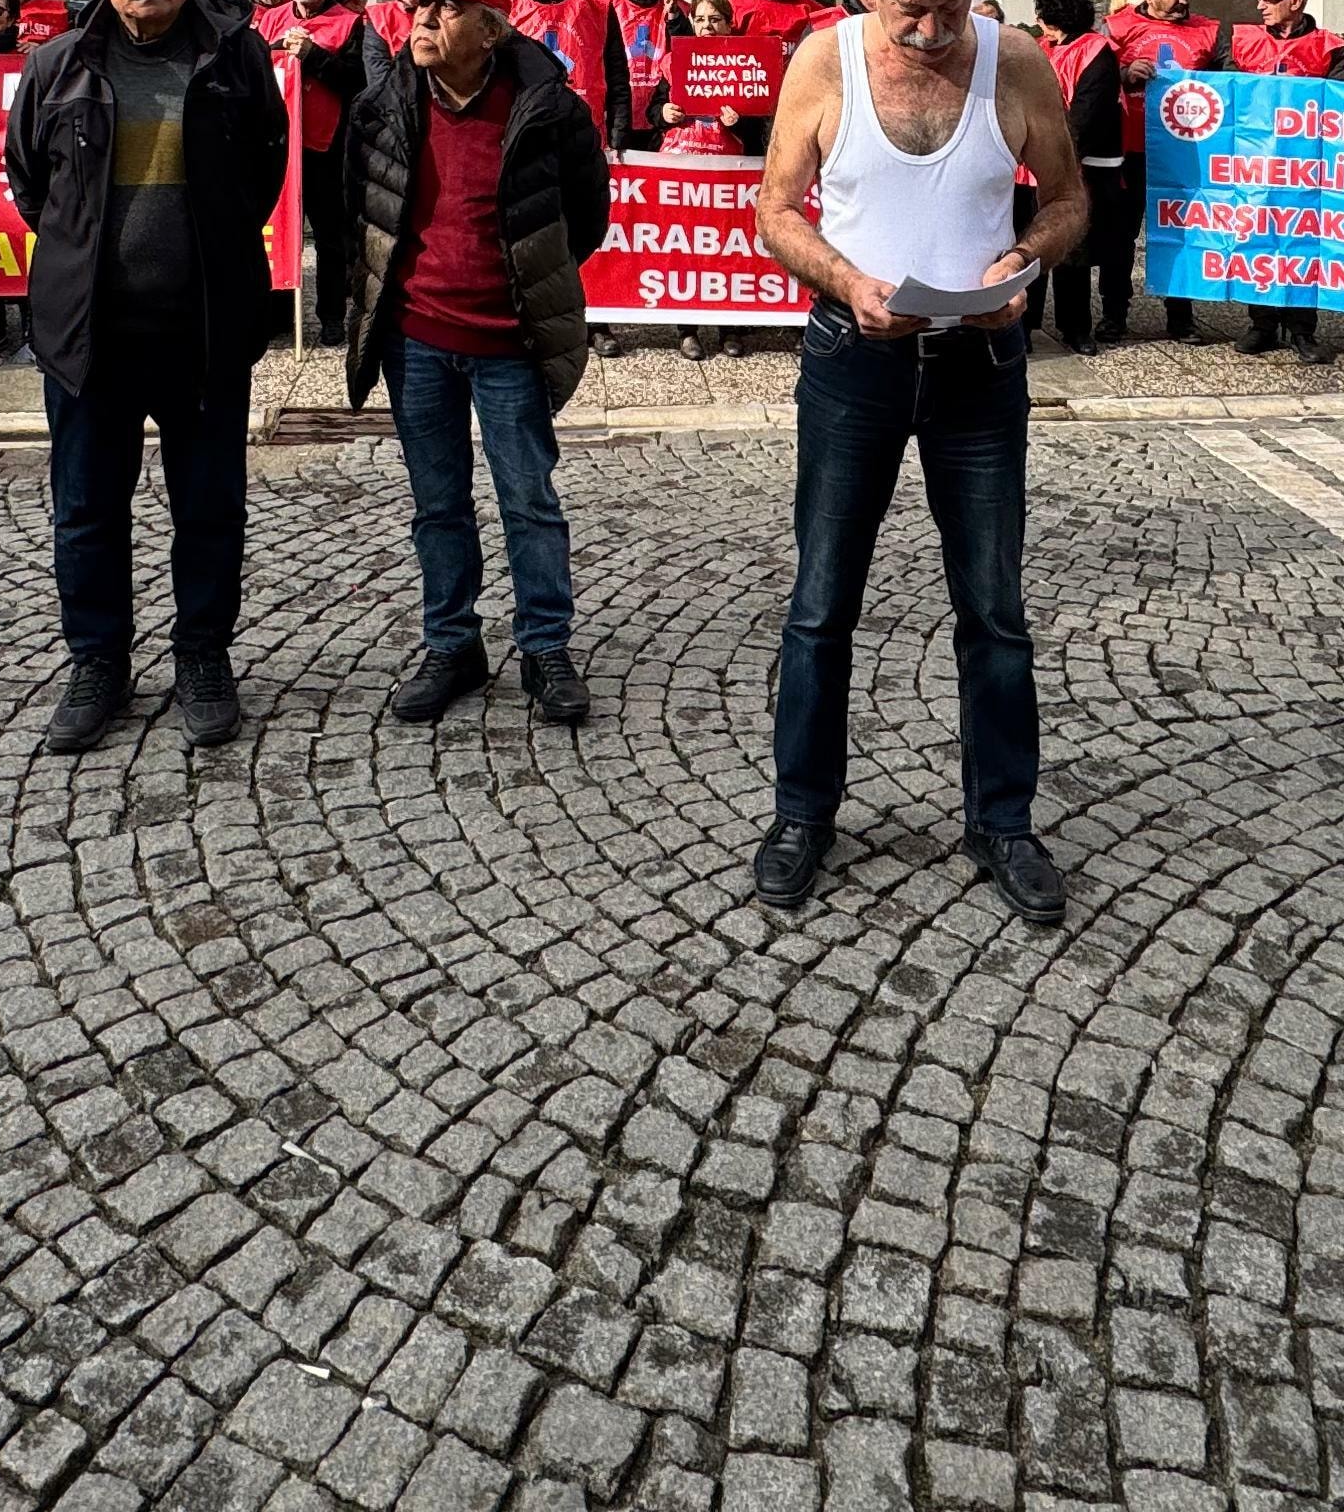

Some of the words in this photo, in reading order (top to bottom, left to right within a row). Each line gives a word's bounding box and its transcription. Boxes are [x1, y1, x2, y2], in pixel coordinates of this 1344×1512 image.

[687, 69, 738, 84] HAKÇA
[742, 67, 767, 82] BİR
[684, 85, 735, 99] YAŞAM
[739, 83, 770, 99] İÇİN
[1176, 100, 1207, 116] DİSK
